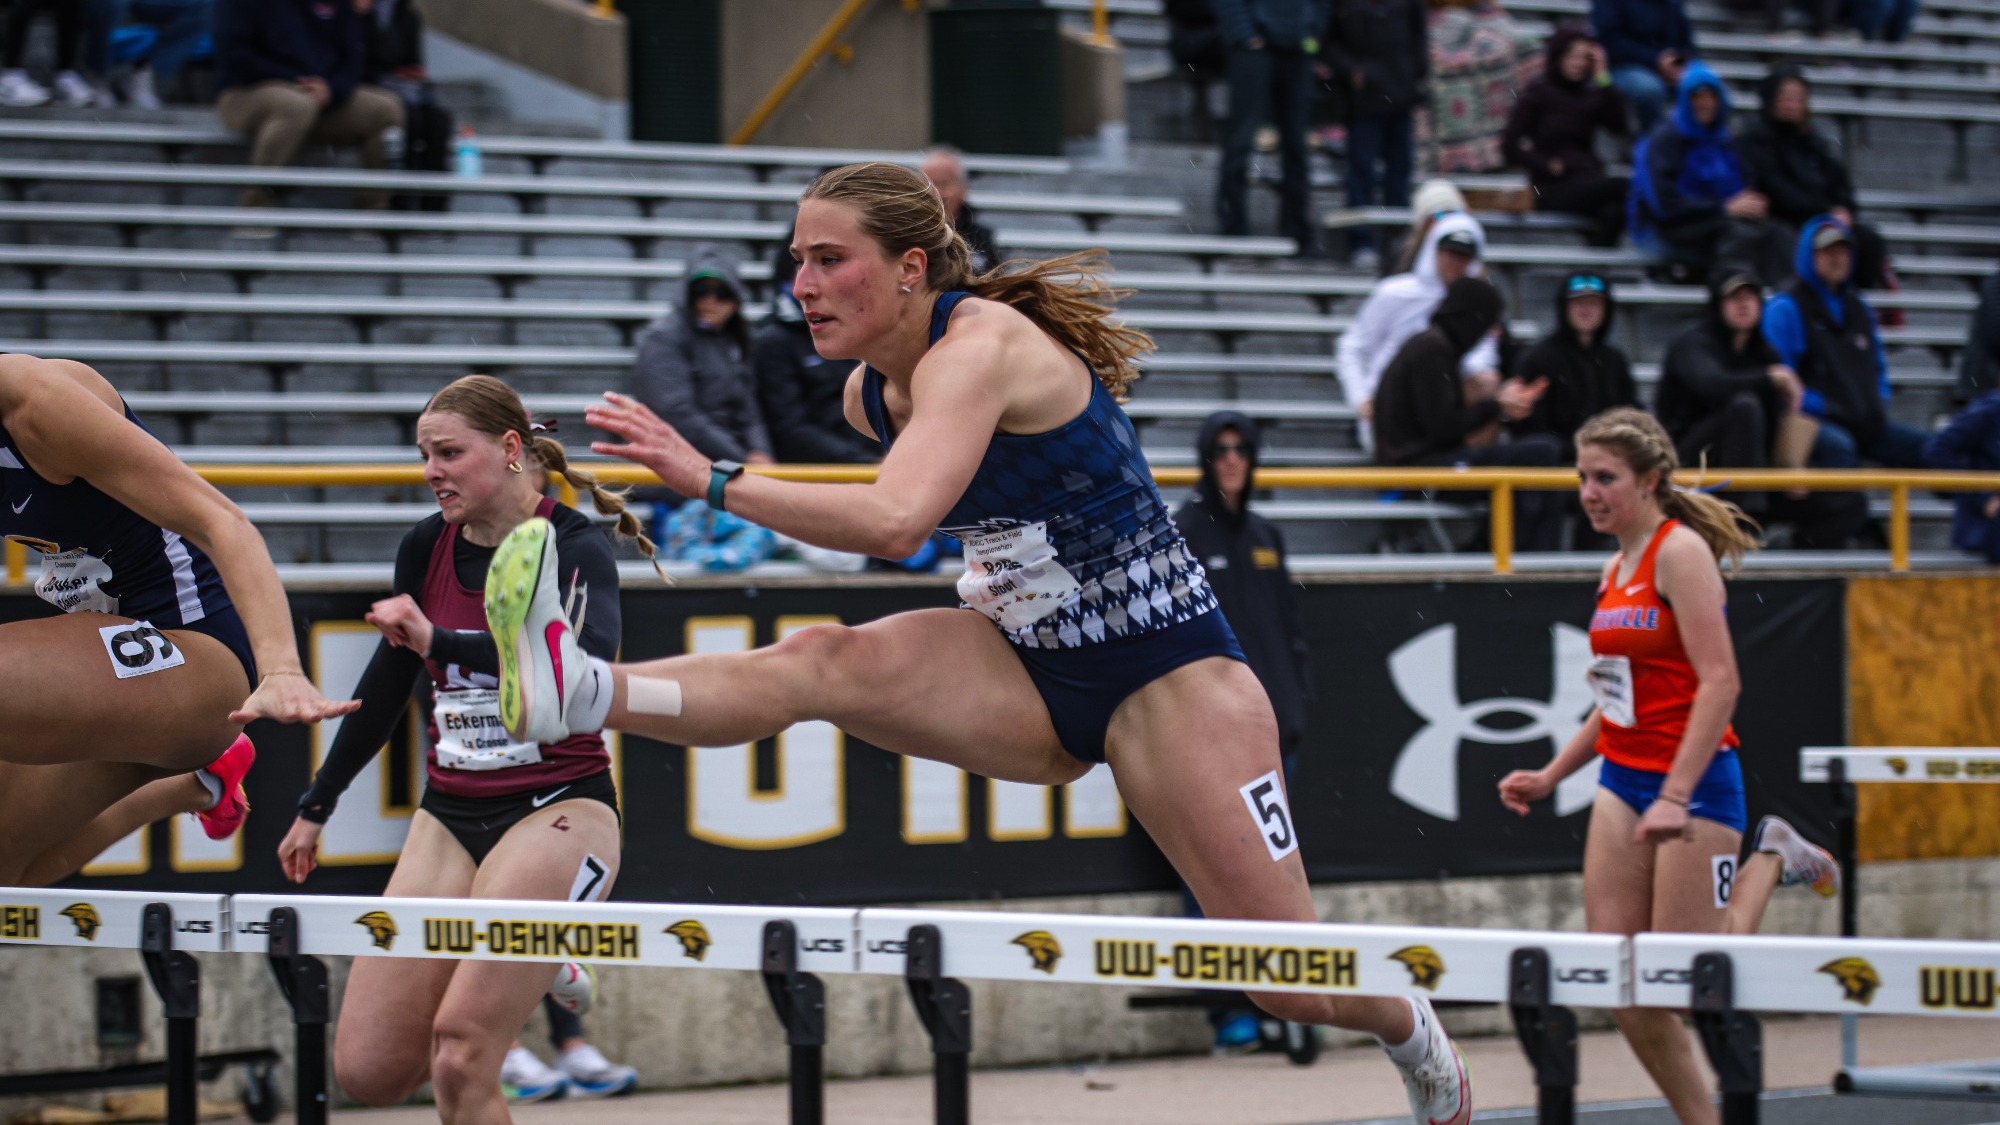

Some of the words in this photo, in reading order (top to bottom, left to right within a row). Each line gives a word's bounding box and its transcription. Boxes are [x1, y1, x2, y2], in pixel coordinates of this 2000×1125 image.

[985, 535, 1003, 546] Track
[1008, 530, 1023, 541] Field
[988, 579, 1018, 598] Stout
[57, 593, 82, 612] Claire
[462, 738, 474, 750] La
[476, 737, 510, 750] Crosse
[1250, 780, 1292, 851] 5
[577, 855, 606, 902] 7
[1718, 860, 1733, 903] 8
[174, 919, 214, 935] UCS
[423, 917, 640, 960] UW-OSHKOSH
[800, 938, 846, 953] UCS
[1094, 939, 1359, 988] UW-OSHKOSH
[1555, 968, 1610, 984] UCS
